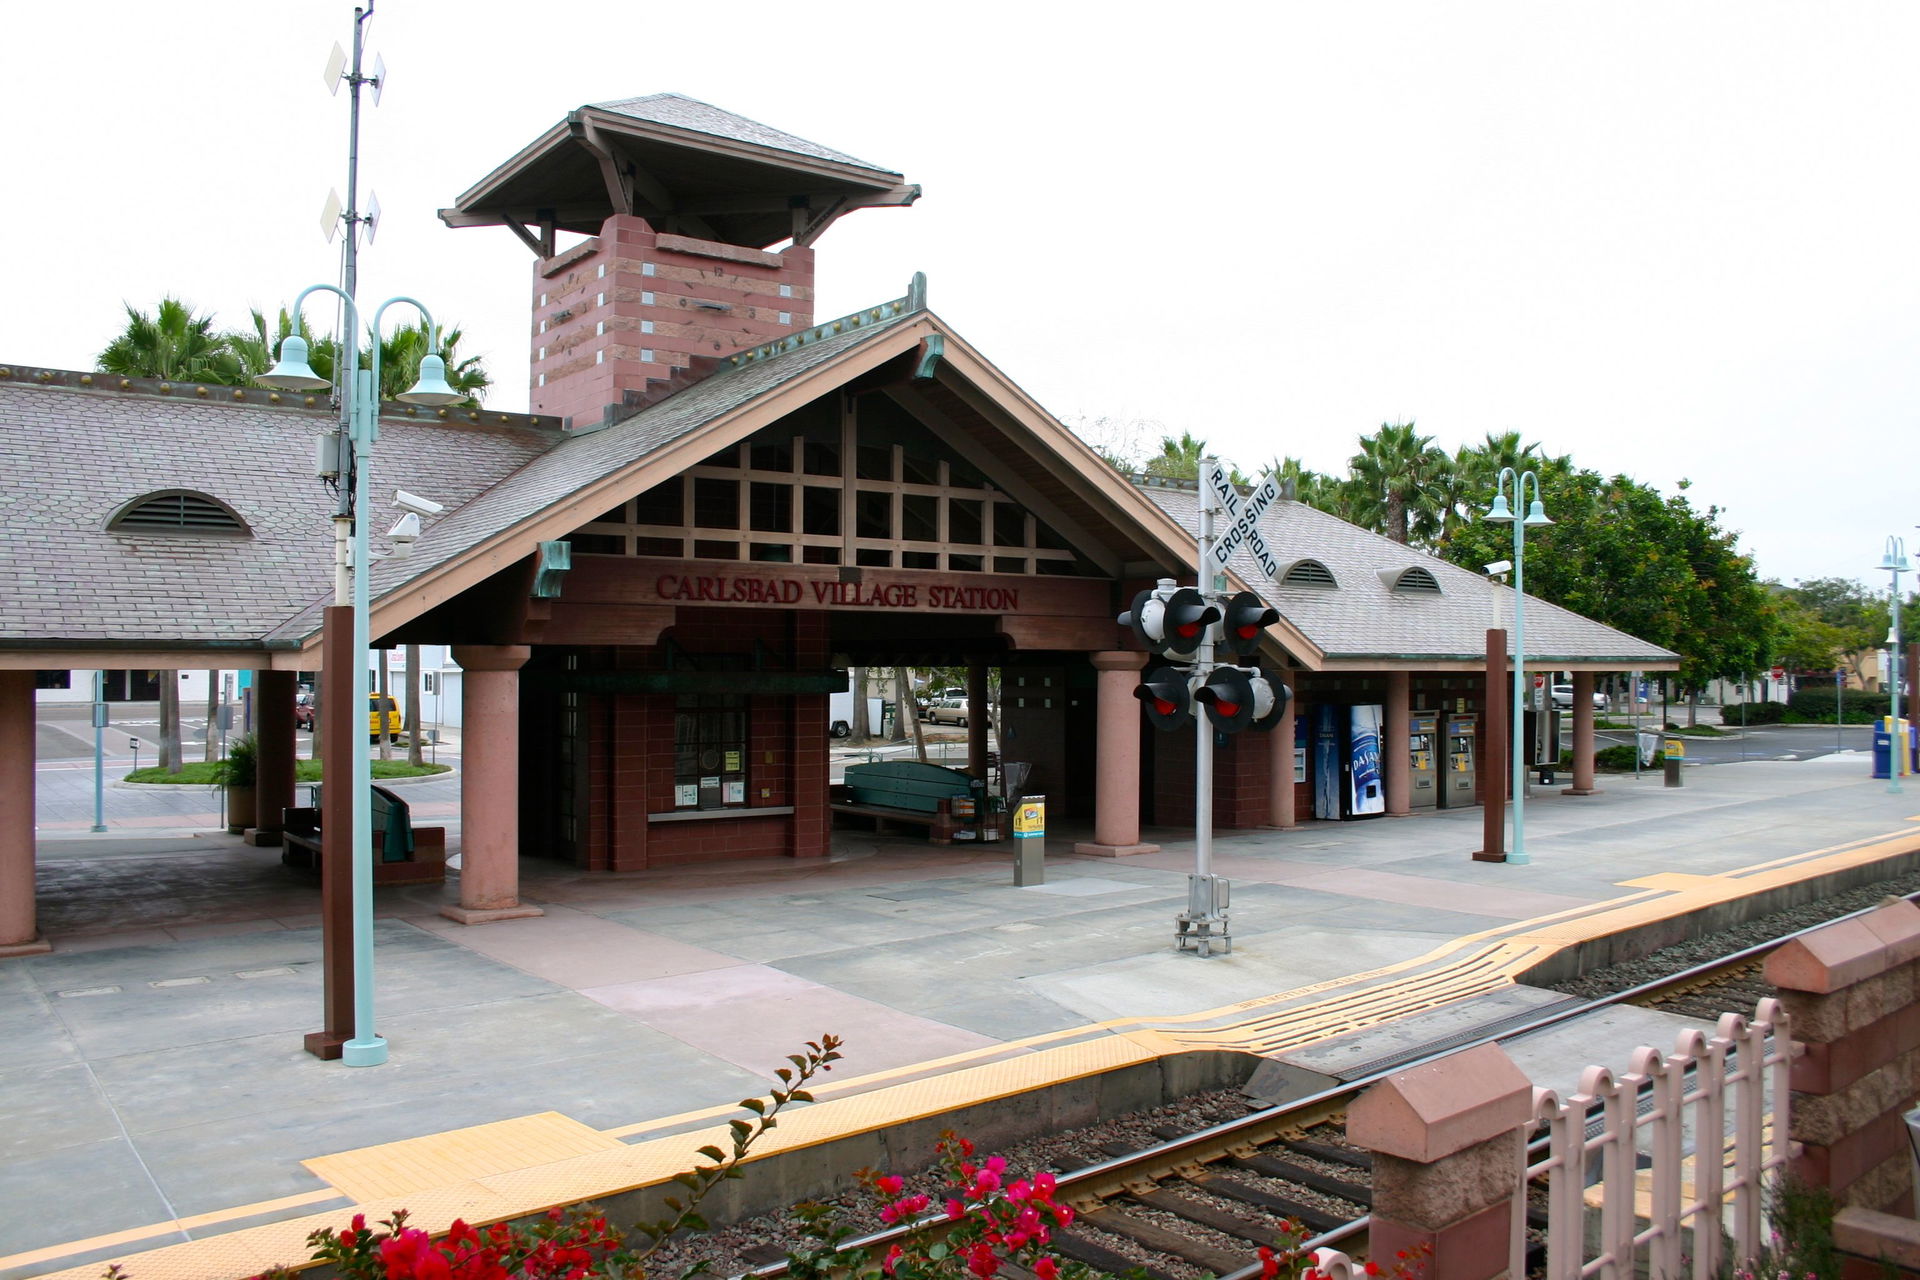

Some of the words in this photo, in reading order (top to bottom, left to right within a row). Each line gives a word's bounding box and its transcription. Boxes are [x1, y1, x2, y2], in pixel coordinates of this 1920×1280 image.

[1211, 469, 1237, 516] RAIL
[1247, 529, 1277, 577] ROAD
[1215, 483, 1275, 564] CROSSING
[656, 575, 803, 604] CARLSBAD
[811, 580, 917, 608] VILLAGE
[928, 585, 1020, 611] STATION
